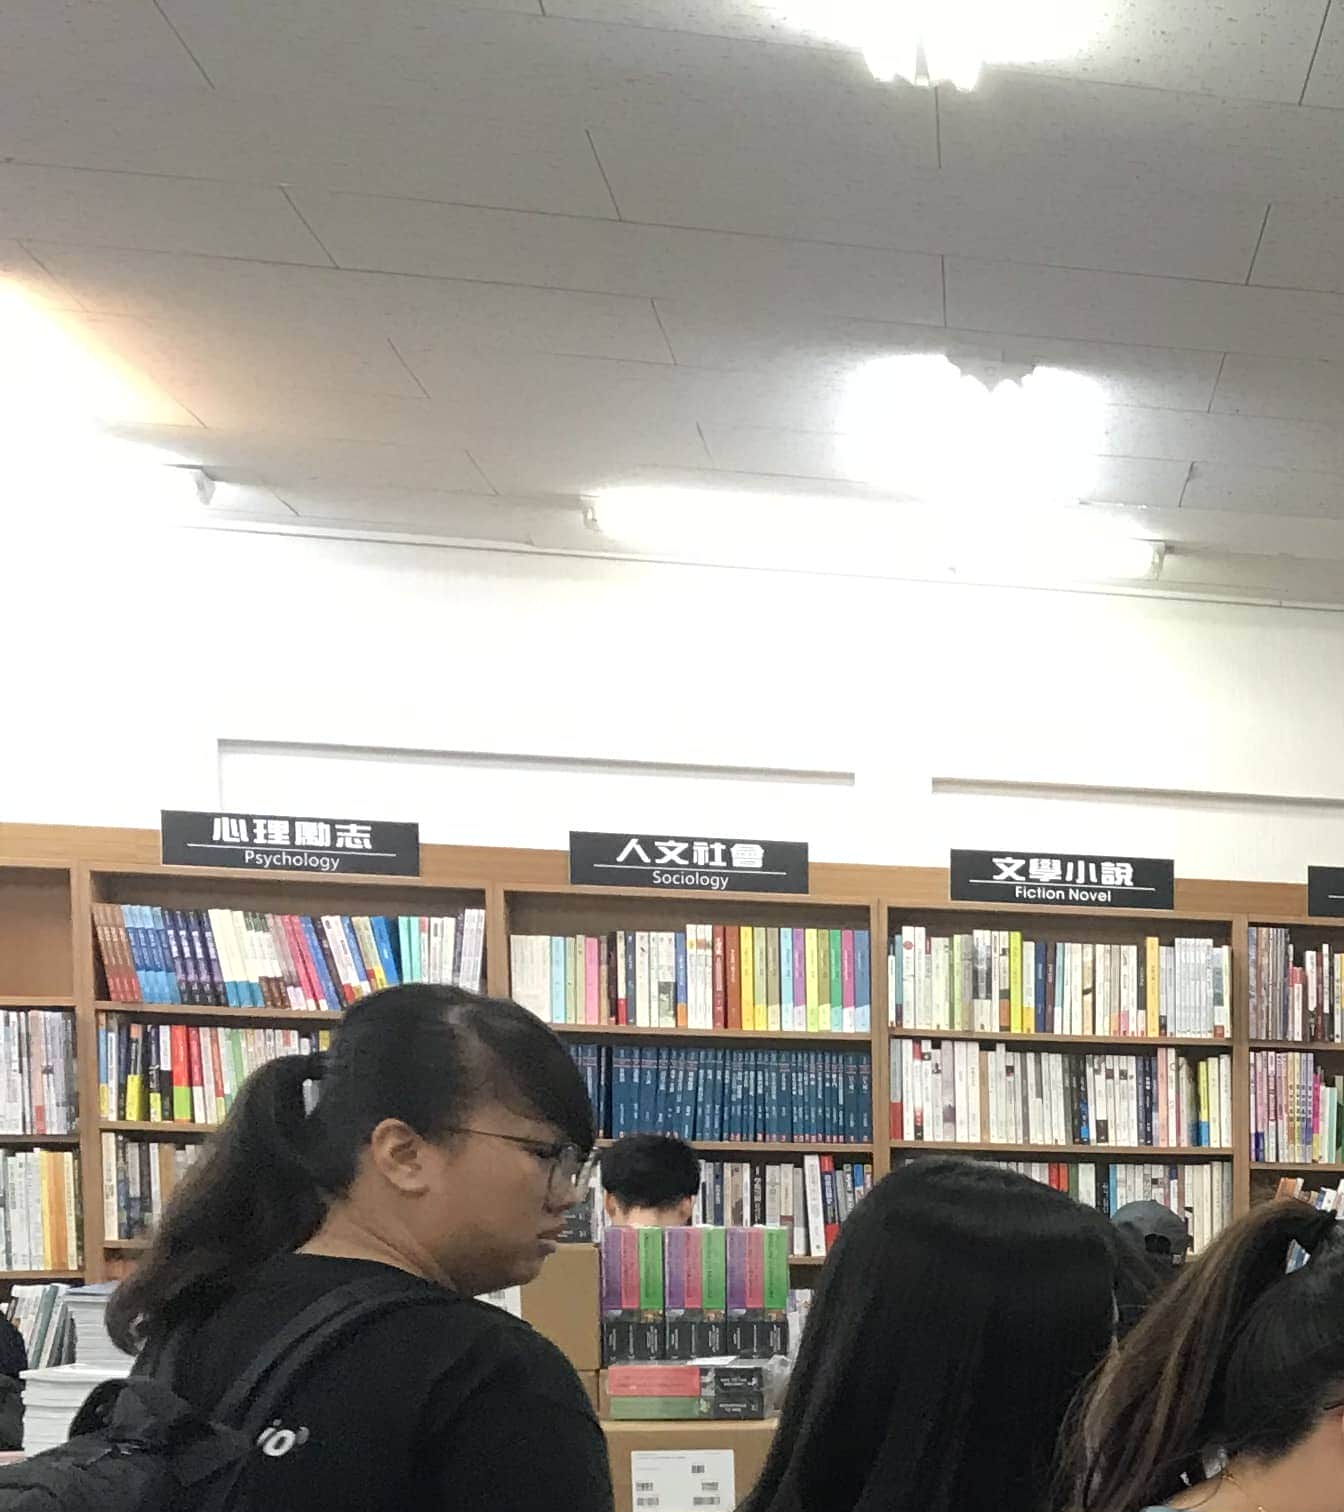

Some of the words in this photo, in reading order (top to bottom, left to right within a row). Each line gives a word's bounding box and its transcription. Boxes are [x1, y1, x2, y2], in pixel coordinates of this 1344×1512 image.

[212, 816, 373, 849] 心理勵志
[244, 850, 340, 872] Psychology
[616, 838, 764, 868] 人文社會
[652, 870, 729, 890] Sociology
[992, 857, 1134, 886] 文學小說
[1015, 885, 1065, 901] Fiction
[1069, 888, 1112, 902] Novel
